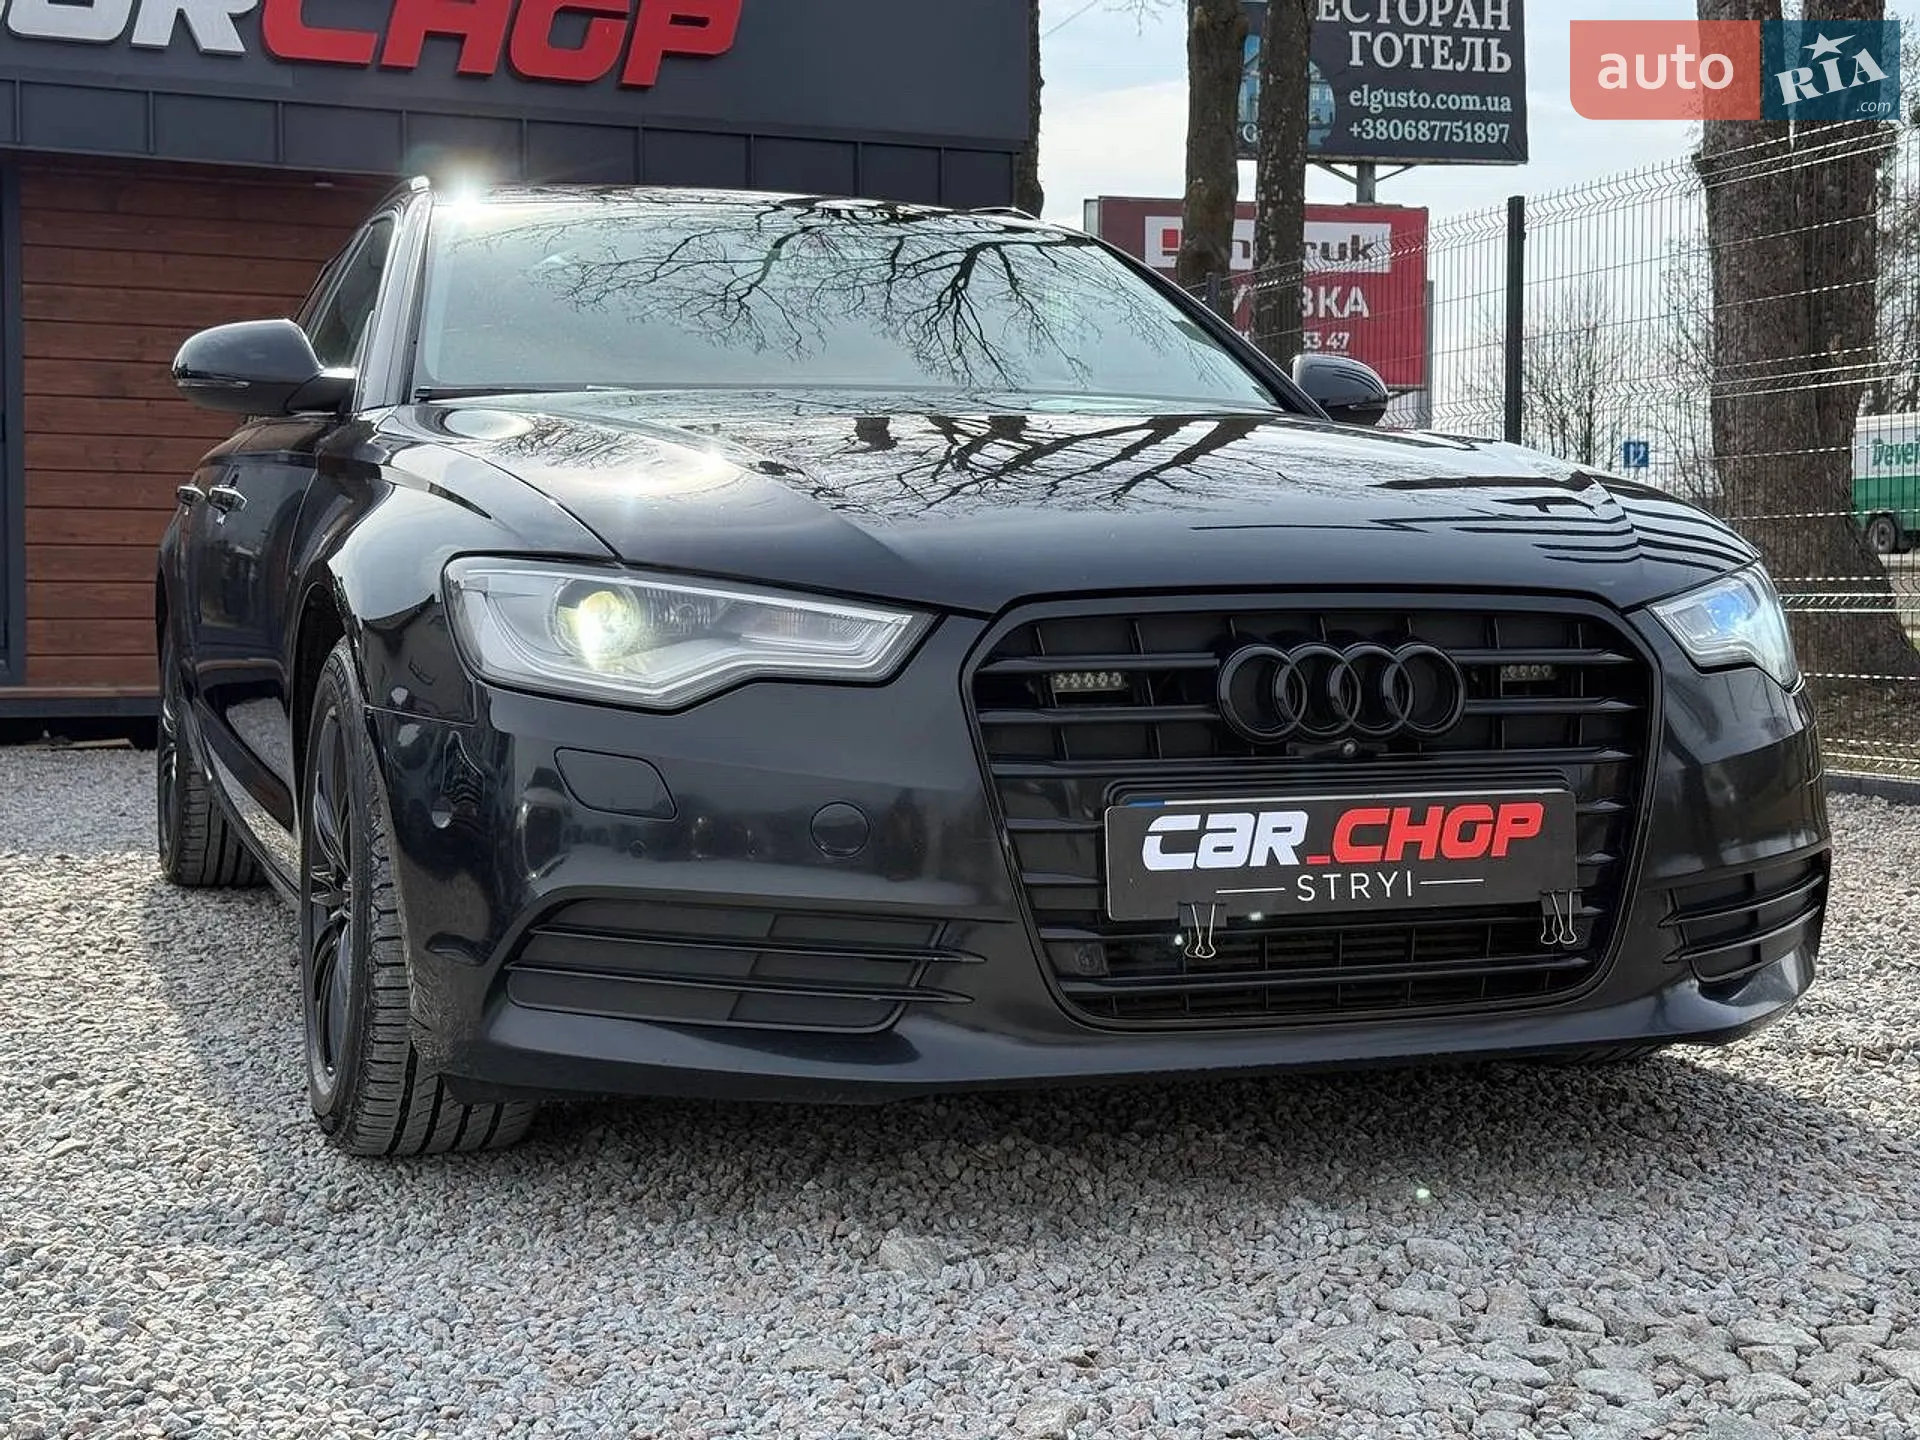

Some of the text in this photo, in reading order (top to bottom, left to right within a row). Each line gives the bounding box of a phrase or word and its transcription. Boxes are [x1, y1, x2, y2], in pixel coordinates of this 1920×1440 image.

[1315, 0, 1511, 31] ЕСТОРАН
[1349, 31, 1512, 73] ГОТЕЛЬ
[1350, 85, 1512, 113] elgusto.com.ua
[1350, 118, 1510, 145] +380687751897
[1297, 870, 1413, 903] STRYI
